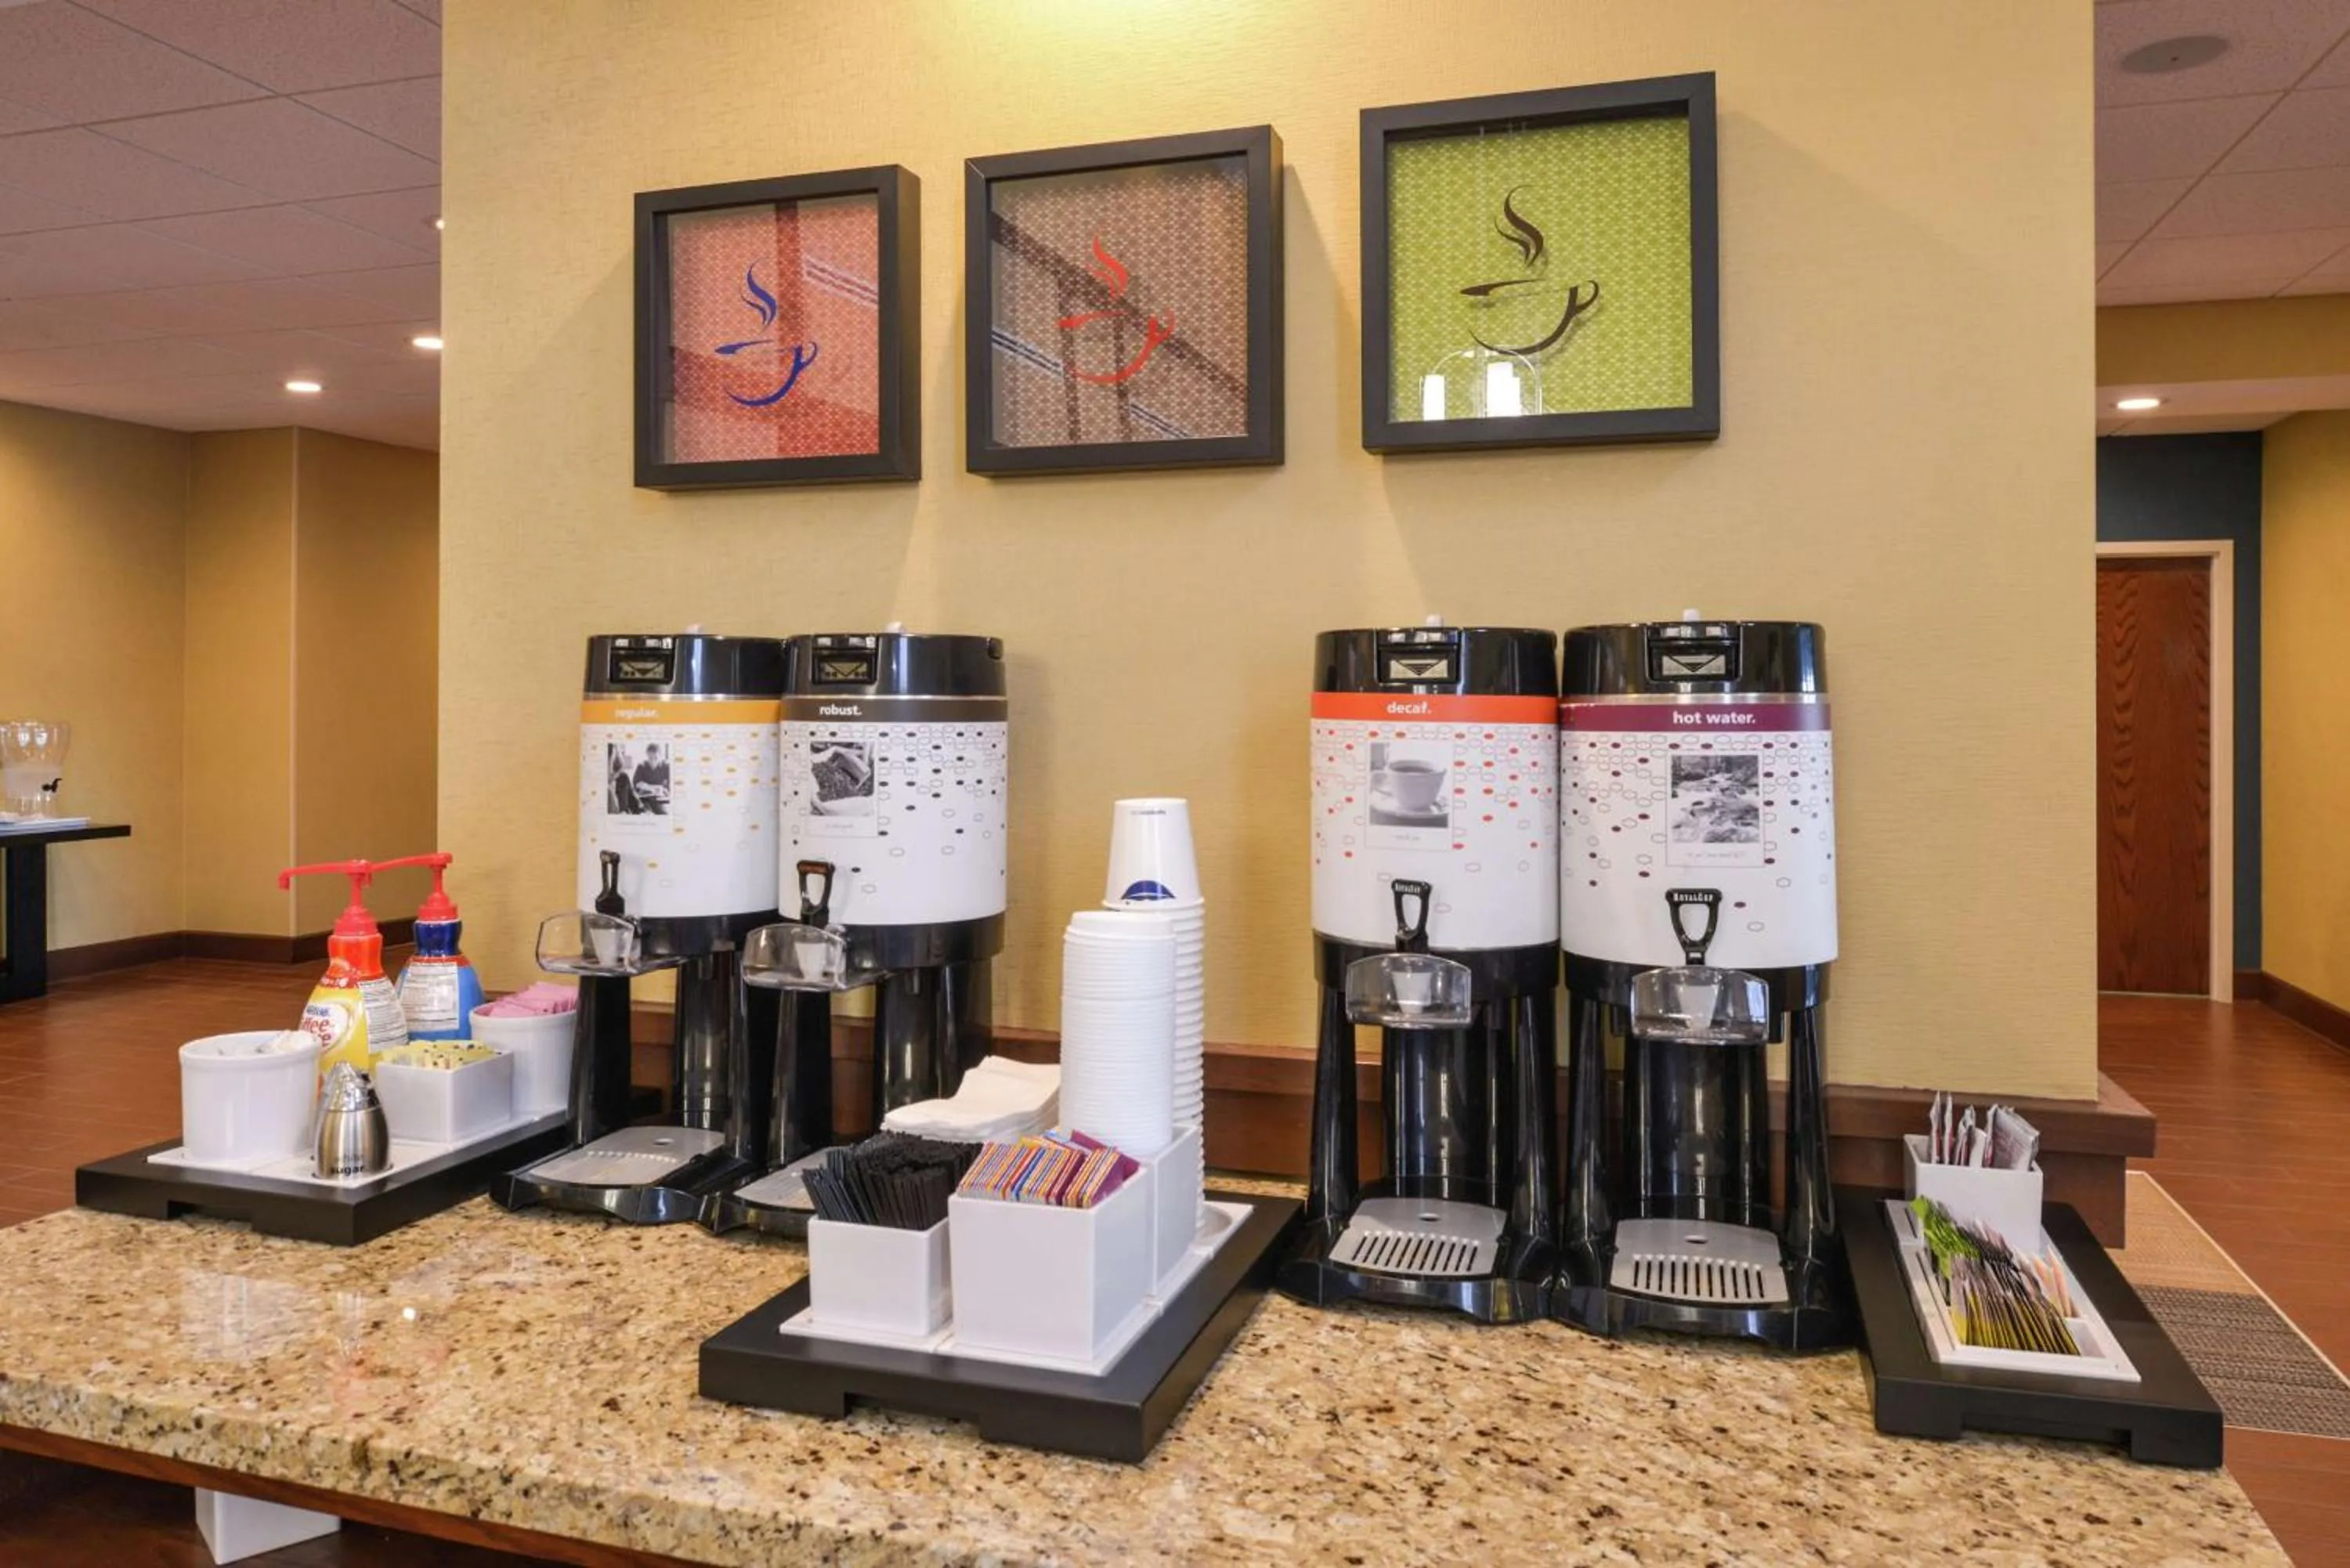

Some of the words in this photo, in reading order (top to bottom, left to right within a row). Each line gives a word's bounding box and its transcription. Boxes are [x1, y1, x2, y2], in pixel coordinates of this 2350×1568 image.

[819, 703, 862, 715] robust.
[1386, 701, 1432, 714] decaf.
[1672, 710, 1701, 724] hot
[1706, 712, 1755, 724] water.
[331, 1165, 364, 1176] sugar
